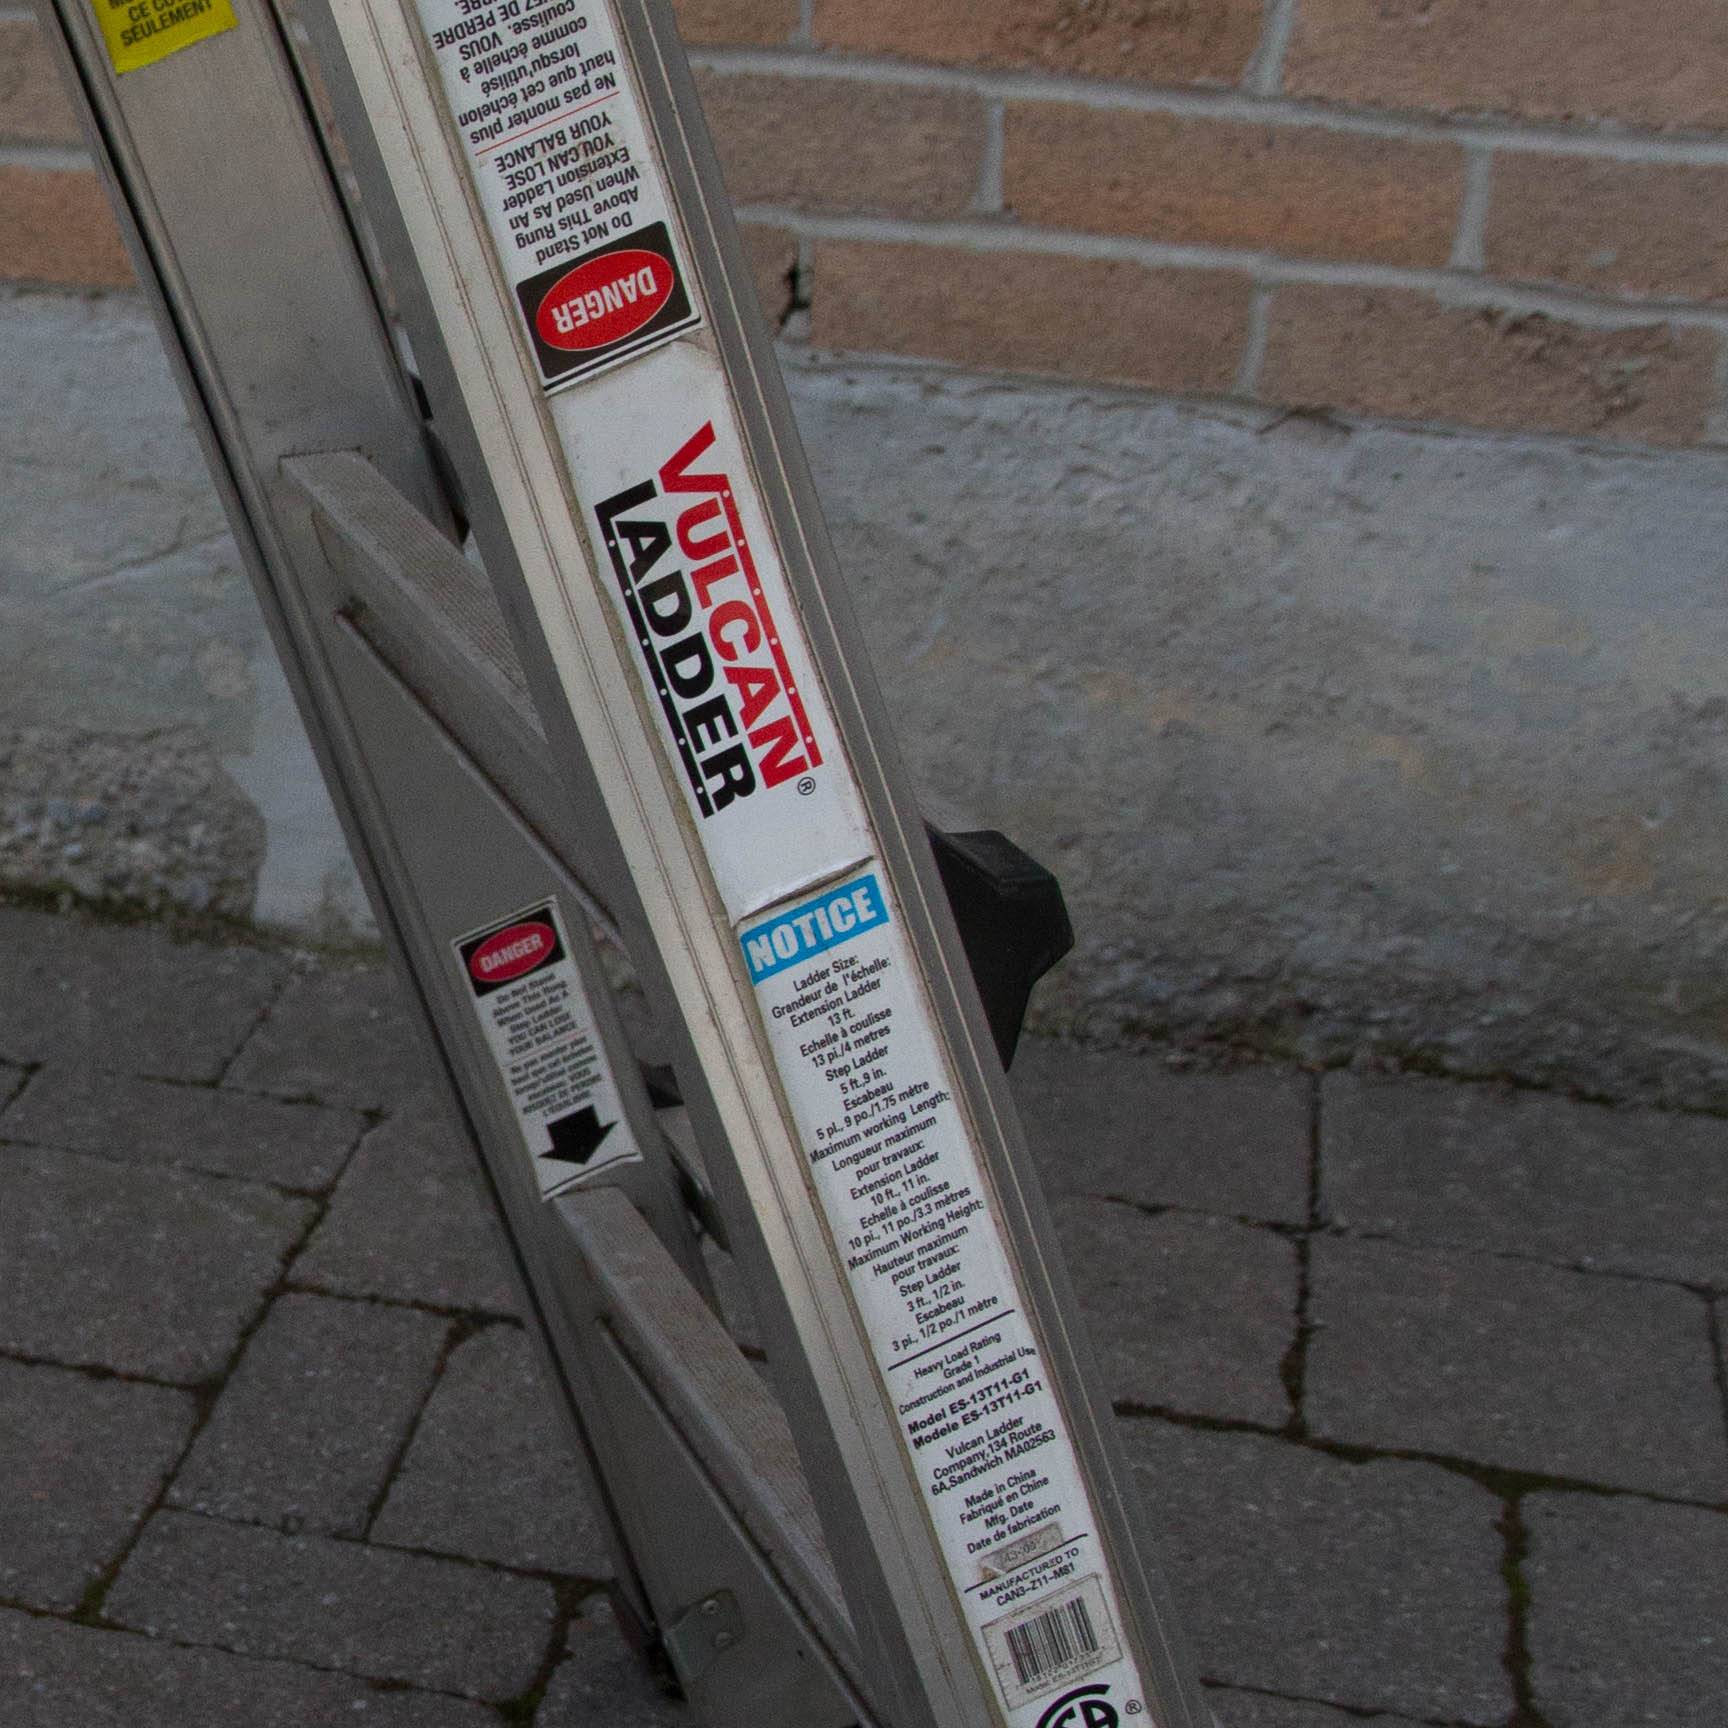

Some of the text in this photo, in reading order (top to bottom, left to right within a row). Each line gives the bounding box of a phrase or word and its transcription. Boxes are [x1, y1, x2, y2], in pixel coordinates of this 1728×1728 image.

[127, 0, 151, 23] CE
[493, 110, 612, 173] YOUR BALANCE
[503, 131, 615, 191] YOU CAN LOSE
[502, 145, 630, 212] Extension Ladder
[508, 164, 640, 230] When Used As An
[514, 185, 638, 249] Above This Rung
[534, 210, 633, 266] Do Not Stand
[550, 265, 657, 333] DANGER
[658, 419, 823, 790] VULCAN
[593, 477, 757, 820] LADDER
[479, 932, 543, 972] DANGER
[747, 886, 876, 971] NOTICE
[792, 956, 859, 992] Ladder Size:
[770, 988, 822, 1019] Grandeur
[823, 980, 838, 995] de
[789, 977, 881, 1028] Extension Ladder
[827, 1007, 855, 1026] 13 ft.
[799, 1007, 892, 1057] Echelle à coulisse
[811, 1053, 825, 1068] 13
[824, 1045, 888, 1082] Step Ladder
[839, 1082, 849, 1095] 5
[871, 1067, 887, 1080] in.
[842, 1081, 894, 1111] Escabeau
[912, 1332, 1002, 1379] Heavy Load Rating
[906, 1367, 1029, 1435] Model ES-13T11-G1
[911, 1379, 1042, 1450] Modele ES-13T11-G1
[944, 1415, 1023, 1459] Vulcan Ladder
[1003, 1428, 1056, 1461] MA02563
[1007, 1422, 1042, 1444] Route
[963, 1468, 1036, 1508] Made in China
[1008, 1500, 1034, 1517] Date
[966, 1503, 1061, 1554] Date de fabrication
